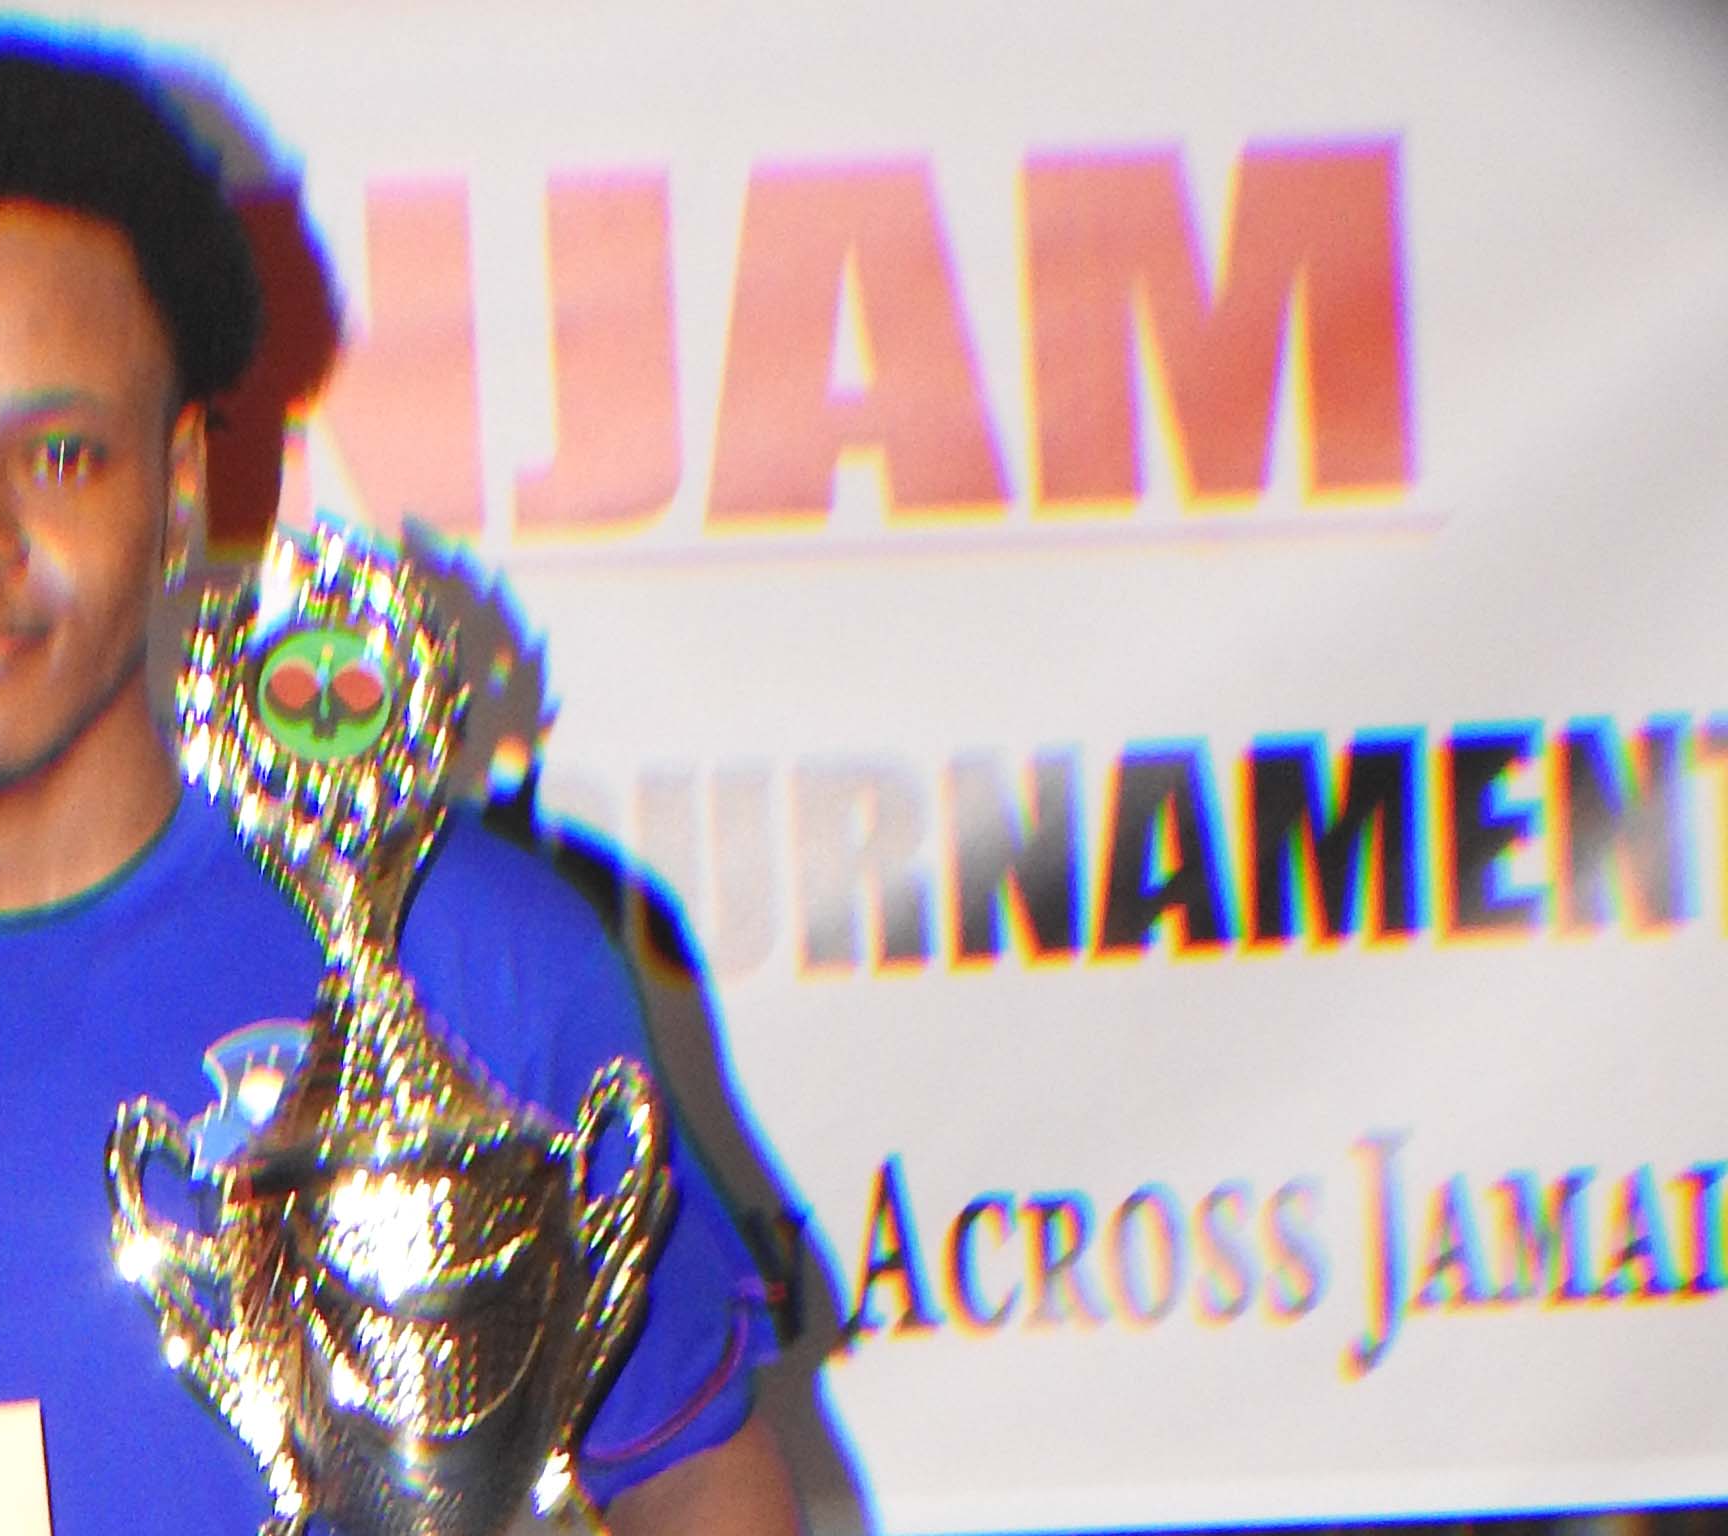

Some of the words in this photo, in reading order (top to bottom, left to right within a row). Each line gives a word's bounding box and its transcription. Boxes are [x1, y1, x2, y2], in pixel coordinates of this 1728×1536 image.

[484, 710, 1728, 988] URNAMEN
[842, 1152, 1332, 1345] ACROSS
[1337, 1122, 1728, 1384] JAMAI
